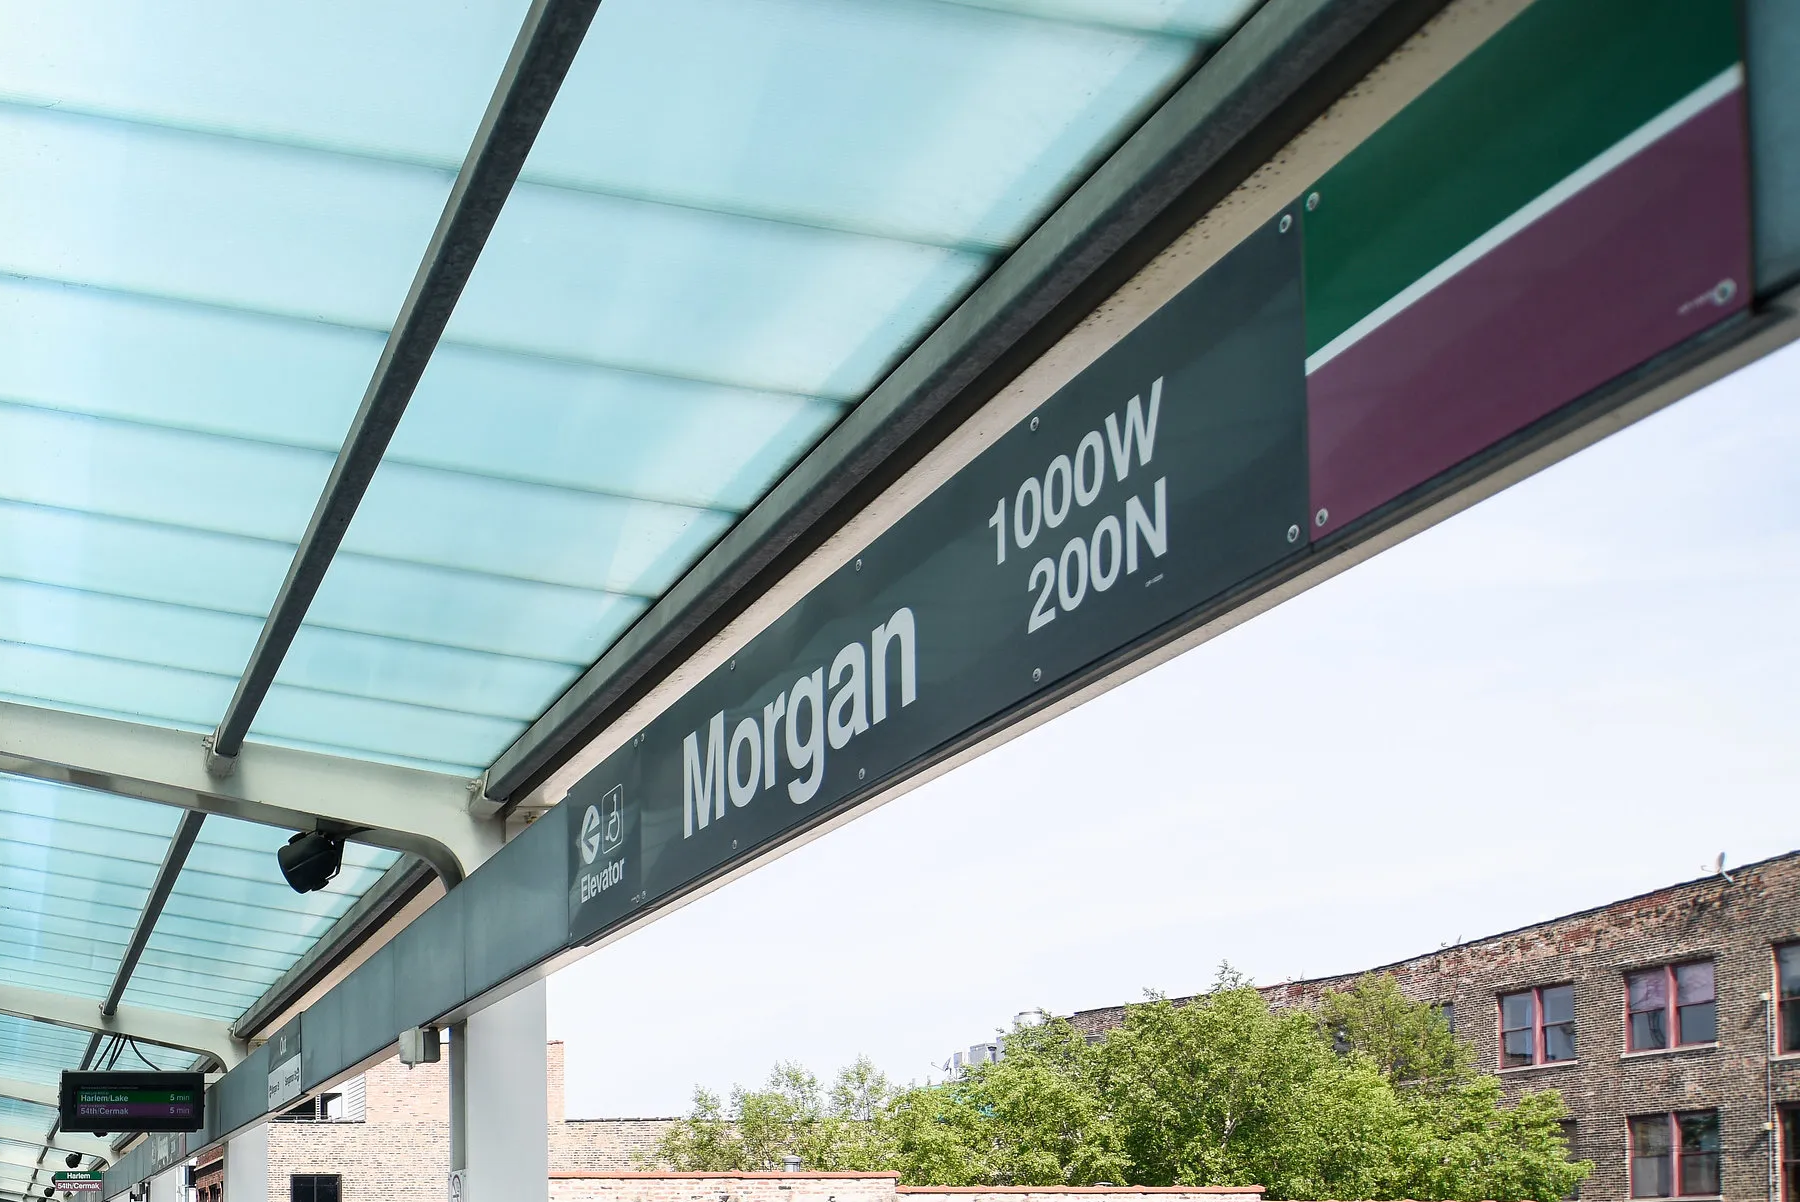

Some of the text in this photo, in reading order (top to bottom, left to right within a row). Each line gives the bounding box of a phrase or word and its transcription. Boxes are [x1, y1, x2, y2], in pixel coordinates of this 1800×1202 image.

[988, 376, 1163, 566] 1000W
[1027, 477, 1168, 635] 200N
[682, 606, 918, 840] Morgan
[581, 858, 624, 903] Elevator
[80, 1107, 129, 1115] 54th/Cermak
[57, 1182, 101, 1190] 54th/Cermak
